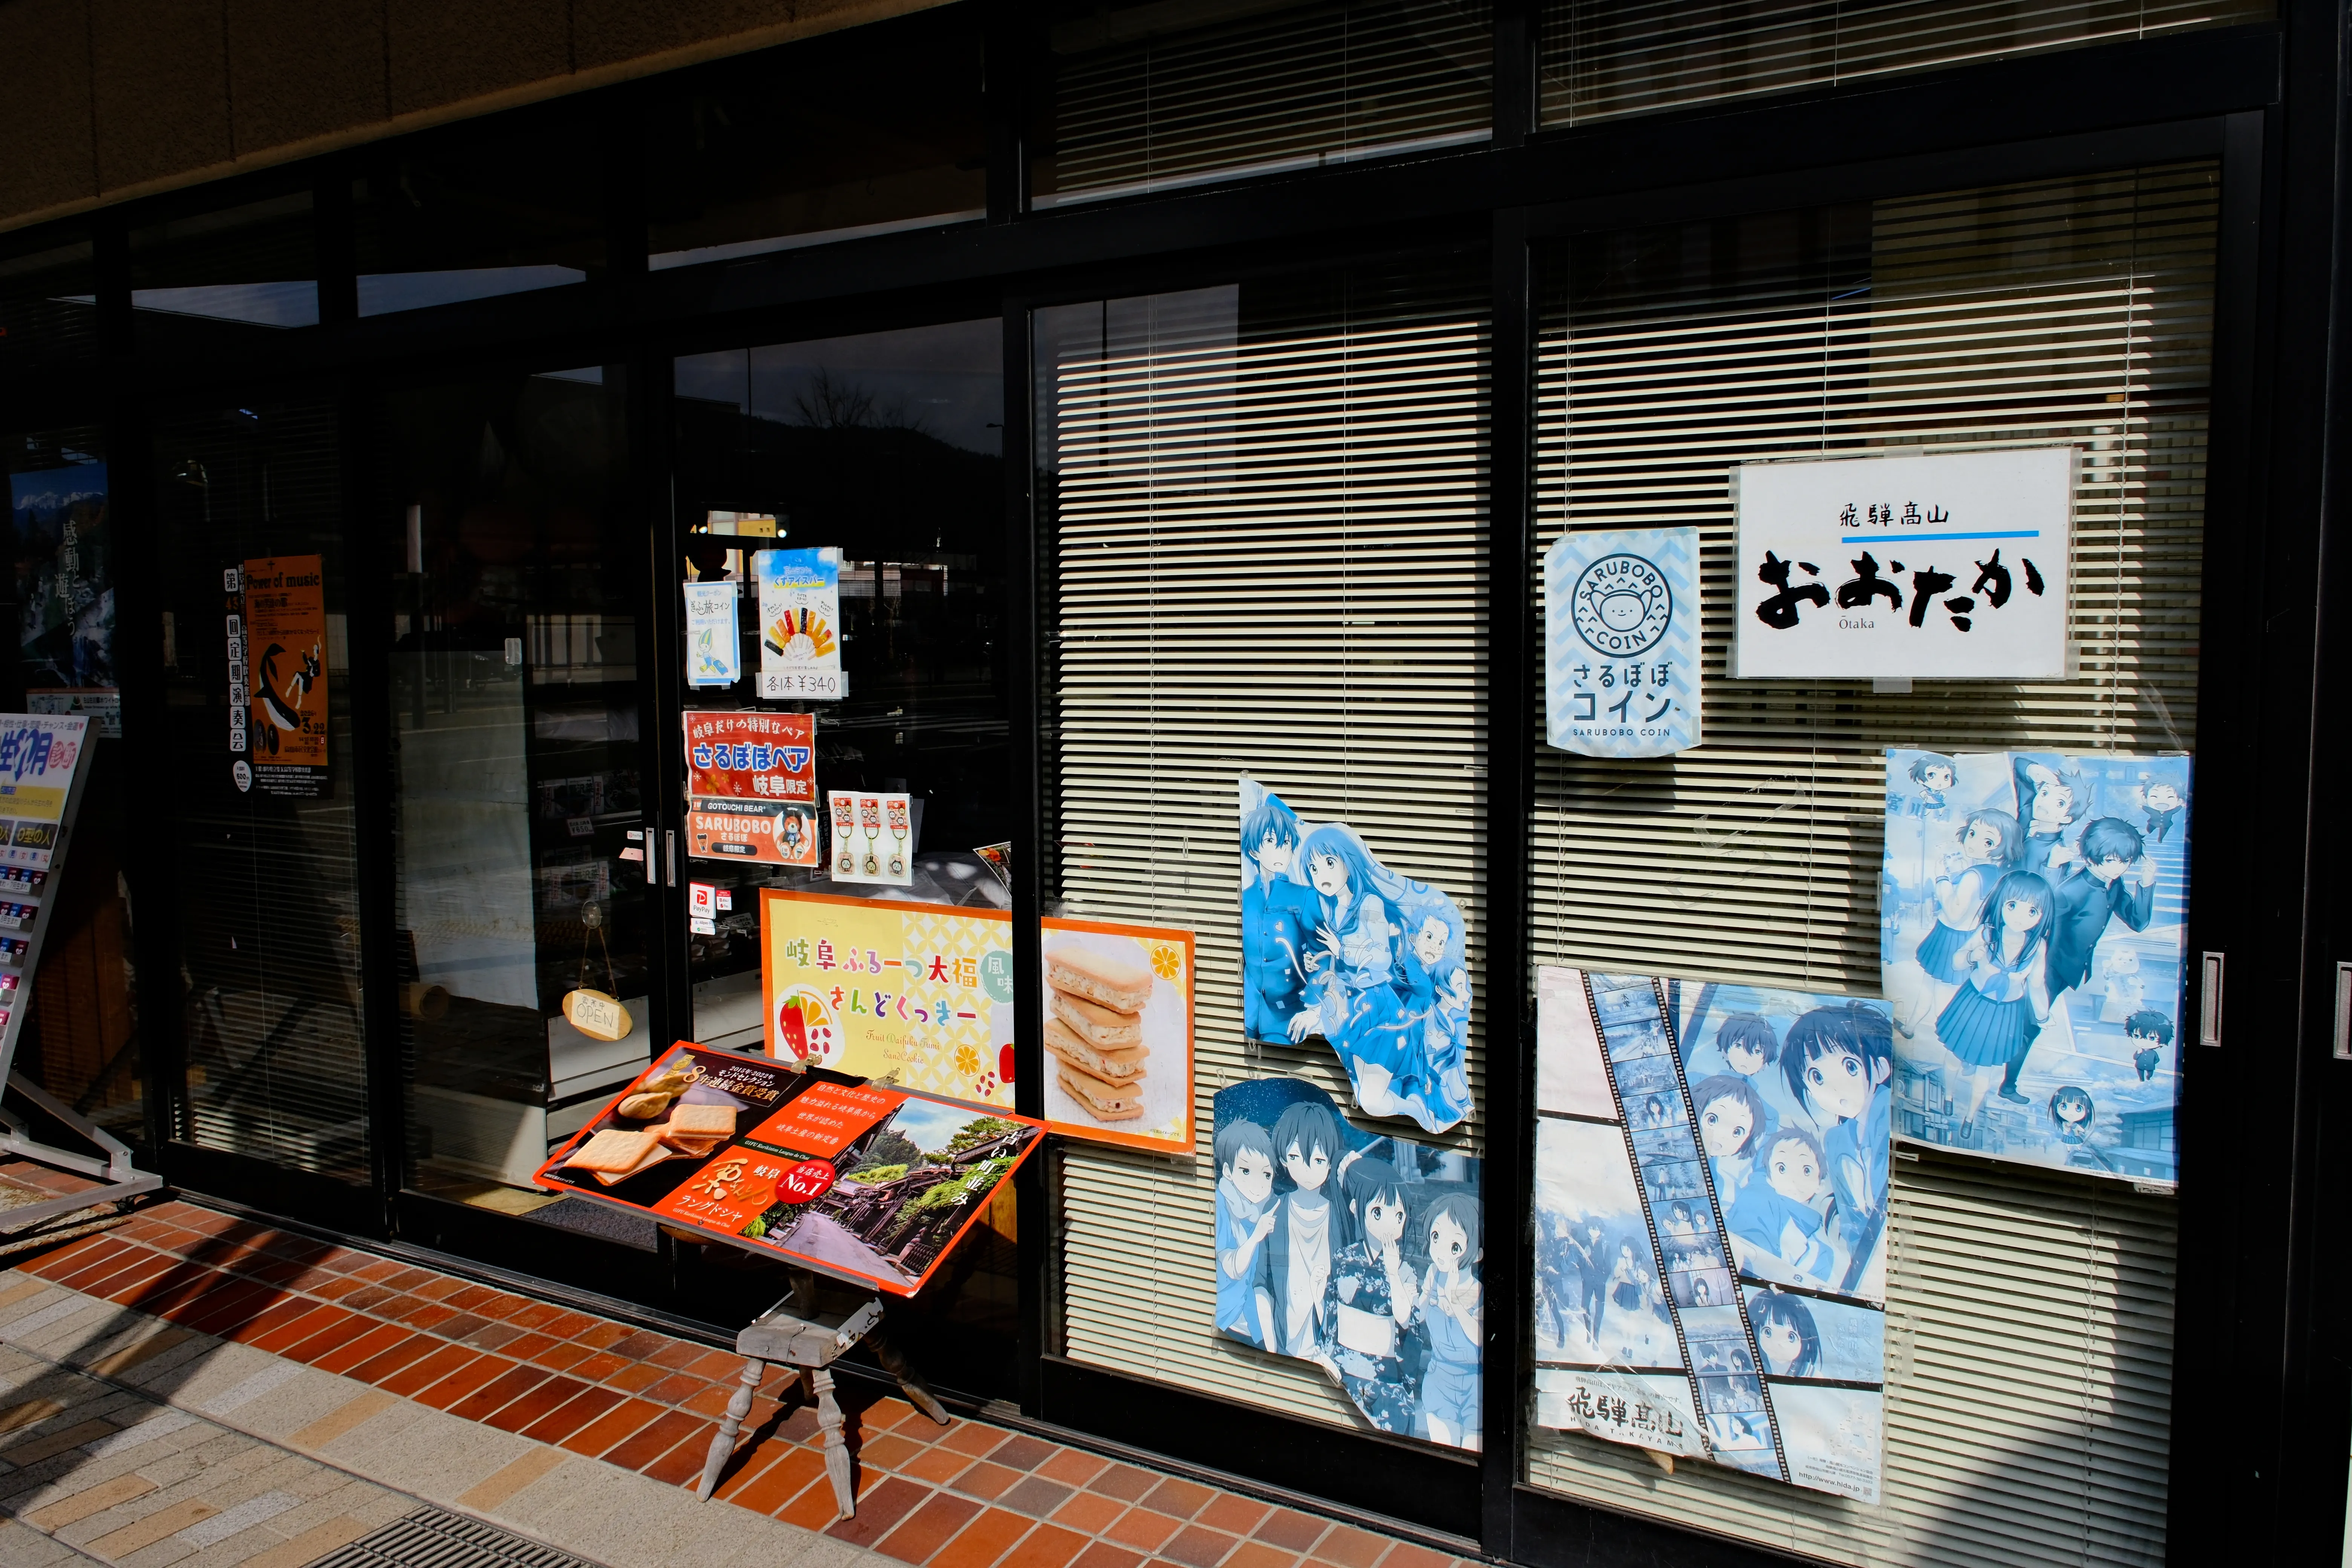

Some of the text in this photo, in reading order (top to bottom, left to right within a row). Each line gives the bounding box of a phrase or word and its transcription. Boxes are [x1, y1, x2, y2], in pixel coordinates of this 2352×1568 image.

[1839, 501, 1949, 528] 飛騨高山
[246, 572, 320, 590] Power of music
[774, 575, 825, 587] くずアイスバー
[1579, 560, 1663, 601] SARUBOBO
[1756, 548, 2045, 632] おおたか
[691, 599, 730, 615] ぎふ旅コイン
[1839, 615, 1874, 630] Ōtaka
[1596, 630, 1647, 650] COIN
[767, 675, 836, 693] 各1本 ¥340
[1573, 661, 1673, 688] さるぼぼ
[1573, 691, 1671, 723] コイン
[693, 717, 805, 740] 岐阜だけの特別なベア
[693, 742, 810, 773] さるぼぼベア
[752, 775, 808, 796] 岐阜限定
[707, 802, 743, 812] GOTOUCHI
[696, 816, 771, 835] SARUBOBO
[721, 832, 748, 842] さるぼぼ
[723, 844, 746, 854] 岐阜限定
[694, 905, 710, 914] PayPay
[786, 939, 1014, 994] 岐阜ふるーつ大福 風味
[577, 1003, 614, 1028] OPEN
[830, 986, 977, 1026] さんどくっきー
[866, 1029, 940, 1050] Fruit Daifuku Fumi
[683, 1065, 780, 1101] 8年連続金賞受賞
[718, 1070, 776, 1087] モンドセレクション
[817, 1084, 886, 1104] 自然と文化と歴史の
[799, 1096, 876, 1119] 魅力溢れる岐阜県から
[796, 1112, 844, 1129] 世界が認めた
[776, 1123, 839, 1145] 岐阜土産の新定番
[779, 1148, 794, 1157] Langue
[753, 1165, 781, 1180] 岐阜
[796, 1165, 830, 1180] 当店売上
[951, 1131, 1023, 1205] 古い町並み
[778, 1173, 823, 1196] No.1
[1567, 1386, 1683, 1438] 飛騨高山
[1570, 1416, 1599, 1431] HIDA
[1799, 1472, 1860, 1492] http://www.hida.jp
